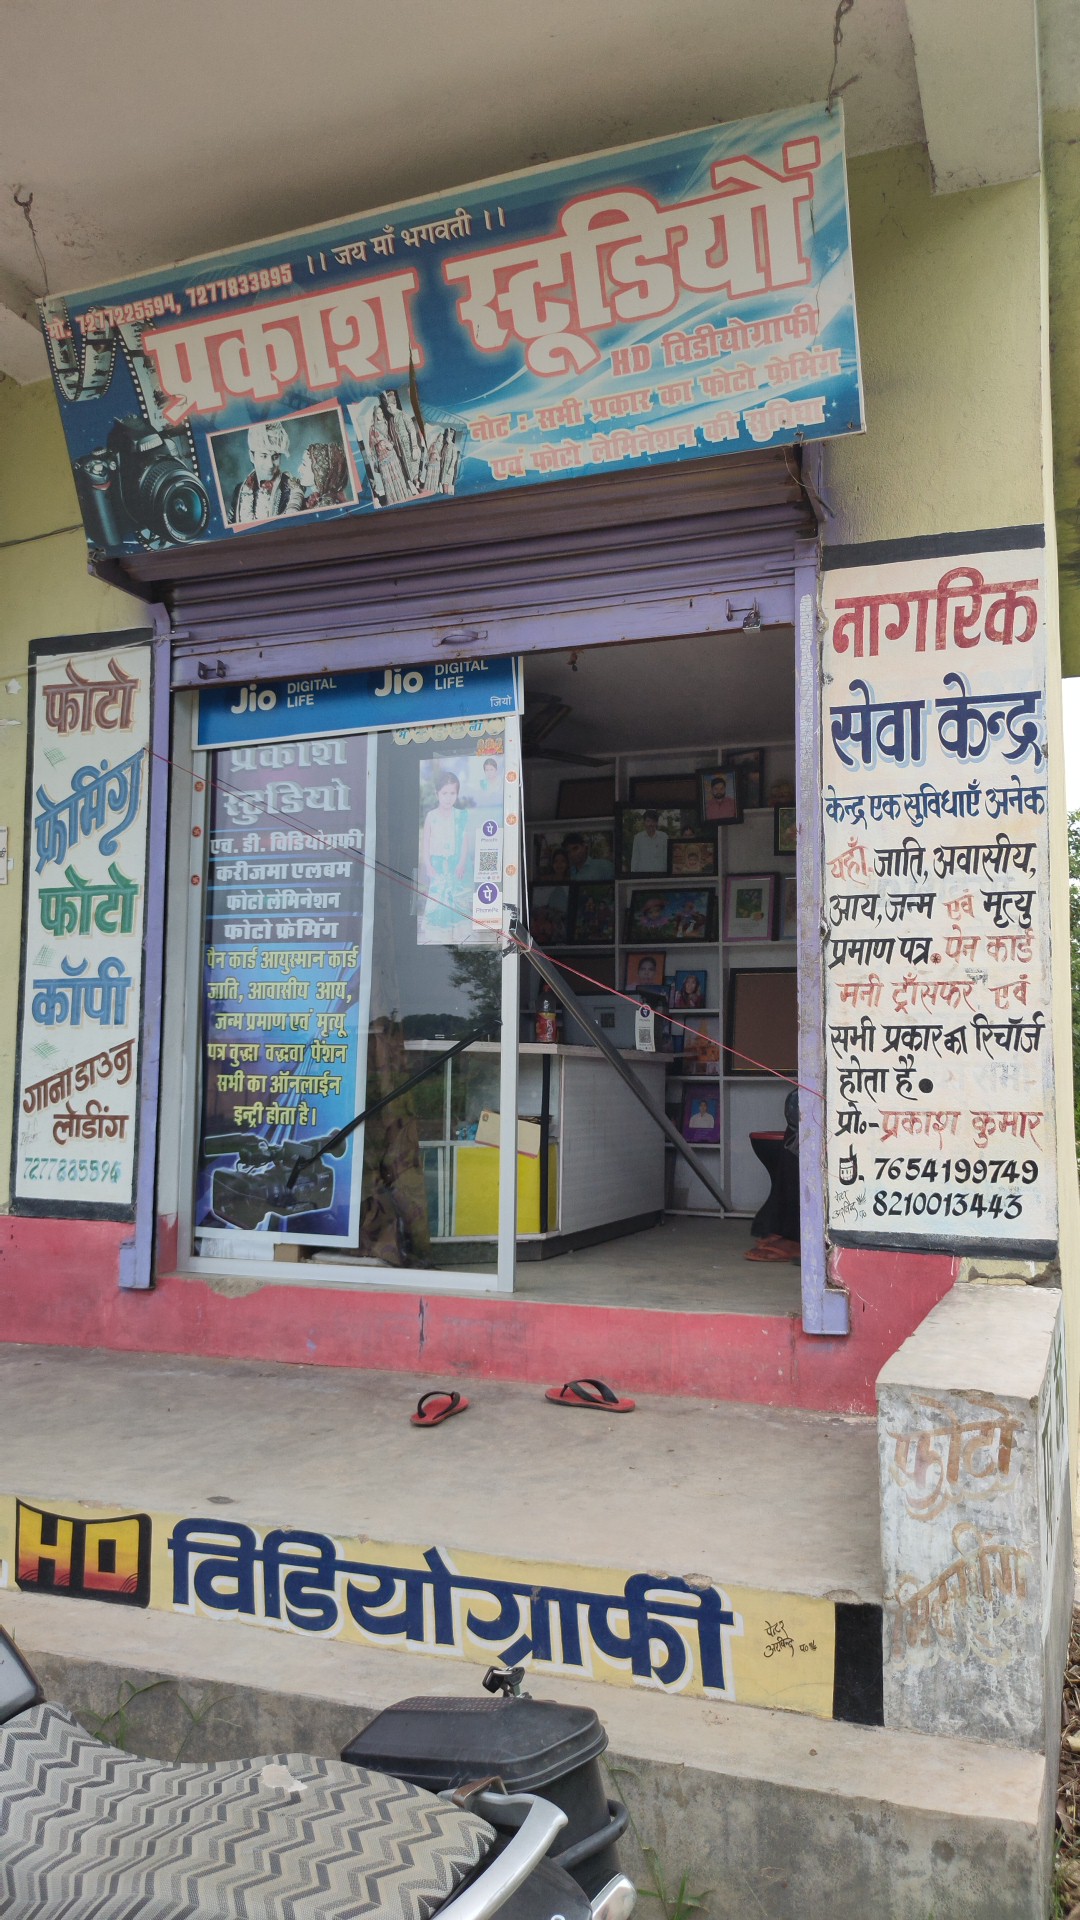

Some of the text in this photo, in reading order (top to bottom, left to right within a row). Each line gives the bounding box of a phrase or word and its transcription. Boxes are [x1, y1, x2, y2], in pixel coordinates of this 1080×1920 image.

[331, 241, 367, 265] जय
[370, 224, 395, 255] माँ
[401, 207, 472, 247] भगवती
[75, 293, 181, 334] 7277225594,
[185, 263, 293, 307] 7277833895
[144, 267, 425, 426] प्रकाश
[611, 304, 819, 376] HD विडीयोग्राफी
[535, 398, 584, 430] सभी
[590, 388, 654, 423] प्रकार
[656, 378, 694, 406] का
[698, 363, 758, 397] फोटो
[764, 345, 841, 387] फ्रेमिंग
[490, 397, 826, 479] एवं फोटो लेमिनेशन की सुविधा
[832, 566, 1039, 658] नागरिक
[287, 677, 337, 695] DIGITAL
[374, 669, 424, 697] Jio
[434, 659, 489, 676] DIGITAL
[434, 676, 465, 691] LIFE
[42, 657, 139, 733] फोटो
[231, 683, 276, 714] Jio
[287, 694, 315, 709] LIFE
[490, 696, 512, 708] जियो
[830, 672, 1043, 768] सेवा केन्द्र
[230, 739, 348, 773] प्रकाश
[35, 747, 145, 875] फ्रेमिंग
[223, 778, 351, 826] स्टुडियो
[824, 775, 1049, 829] केन्द्र एक सुविधाएँ अनेक
[242, 833, 266, 853] डी.
[874, 836, 929, 886] जाति,
[933, 833, 1037, 883] अवासीय,
[216, 861, 353, 882] करीजमा एलबम
[38, 861, 139, 936] फोटो
[226, 888, 341, 911] फोटो लेमिनेशन
[829, 889, 1037, 929] आय, जन्म एवं मृत्यु
[224, 918, 339, 940] फोटो फ्रेमिंग
[828, 937, 896, 970] प्रमाण
[944, 924, 981, 964] पेन
[986, 928, 1035, 964] कार्ड
[228, 946, 258, 969] कार्ड
[327, 945, 359, 968] कार्ड
[32, 955, 132, 1026] कॉपी
[207, 976, 352, 1004] जाति, आवासीय आय,
[836, 972, 885, 1008] मनी
[988, 974, 1031, 1010] एवं
[216, 1012, 244, 1031] जन्म
[246, 1012, 286, 1031] प्रमाण
[289, 1008, 314, 1031] एवं
[829, 1011, 1045, 1060] सभी प्रकार का रिचॉर्ज
[207, 1043, 227, 1061] पत्र
[217, 1070, 342, 1097] सभी का ऑनलाईन
[836, 1054, 889, 1103] होता
[53, 1099, 129, 1145] लोडींग
[266, 1102, 296, 1126] होता
[879, 1109, 961, 1150] प्रकाश
[970, 1110, 1043, 1151] कुमार
[874, 1158, 1039, 1185] 7654199749
[873, 1190, 1023, 1220] 8210013443
[888, 1394, 1023, 1510] फोटो
[168, 1518, 733, 1690] विडियोग्राफी
